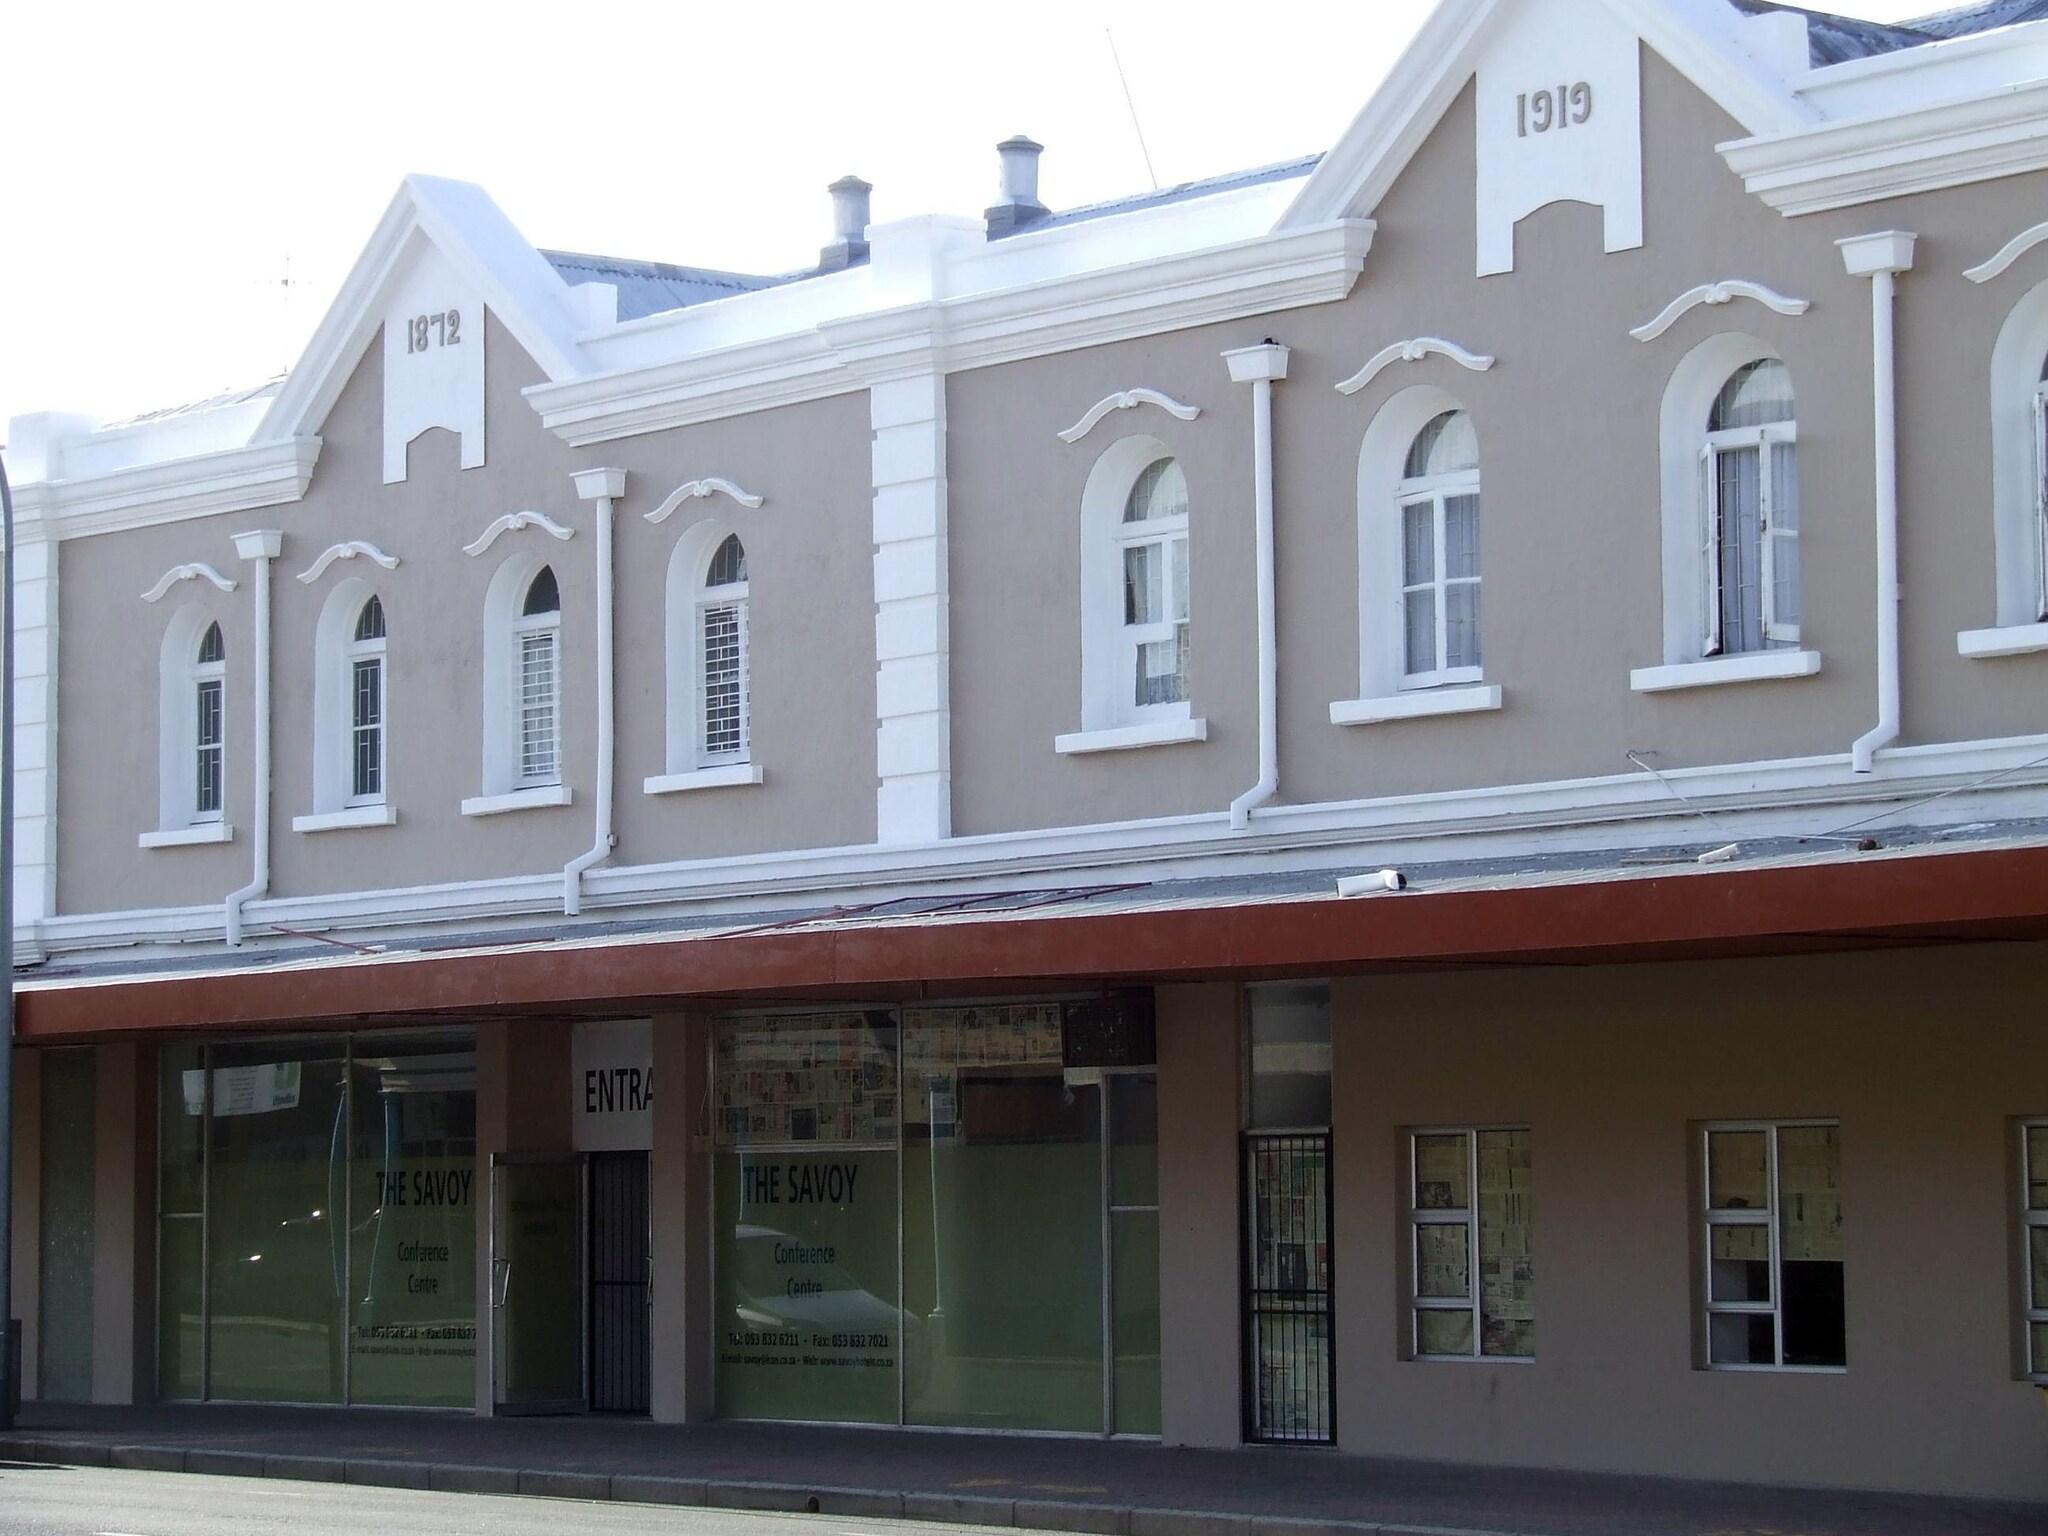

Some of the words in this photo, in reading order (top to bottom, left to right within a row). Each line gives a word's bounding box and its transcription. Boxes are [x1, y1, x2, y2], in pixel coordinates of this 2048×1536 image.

[1516, 81, 1592, 138] 1919
[407, 309, 460, 354] 1872
[585, 1068, 654, 1112] ENTRA
[376, 1170, 406, 1206] THE
[413, 1169, 472, 1206] SAVOY
[743, 1165, 780, 1204] THE
[788, 1164, 858, 1204] SAVOY
[398, 1240, 449, 1262] Conference
[774, 1241, 836, 1265] Conference
[408, 1273, 439, 1295] Centre
[787, 1276, 823, 1299] Centre
[744, 1332, 760, 1346] 053
[761, 1332, 777, 1346] 832
[778, 1333, 800, 1346] 6211
[812, 1334, 830, 1348] Fax:
[832, 1334, 848, 1348] 053
[849, 1334, 865, 1348] 832
[868, 1334, 889, 1348] 7021
